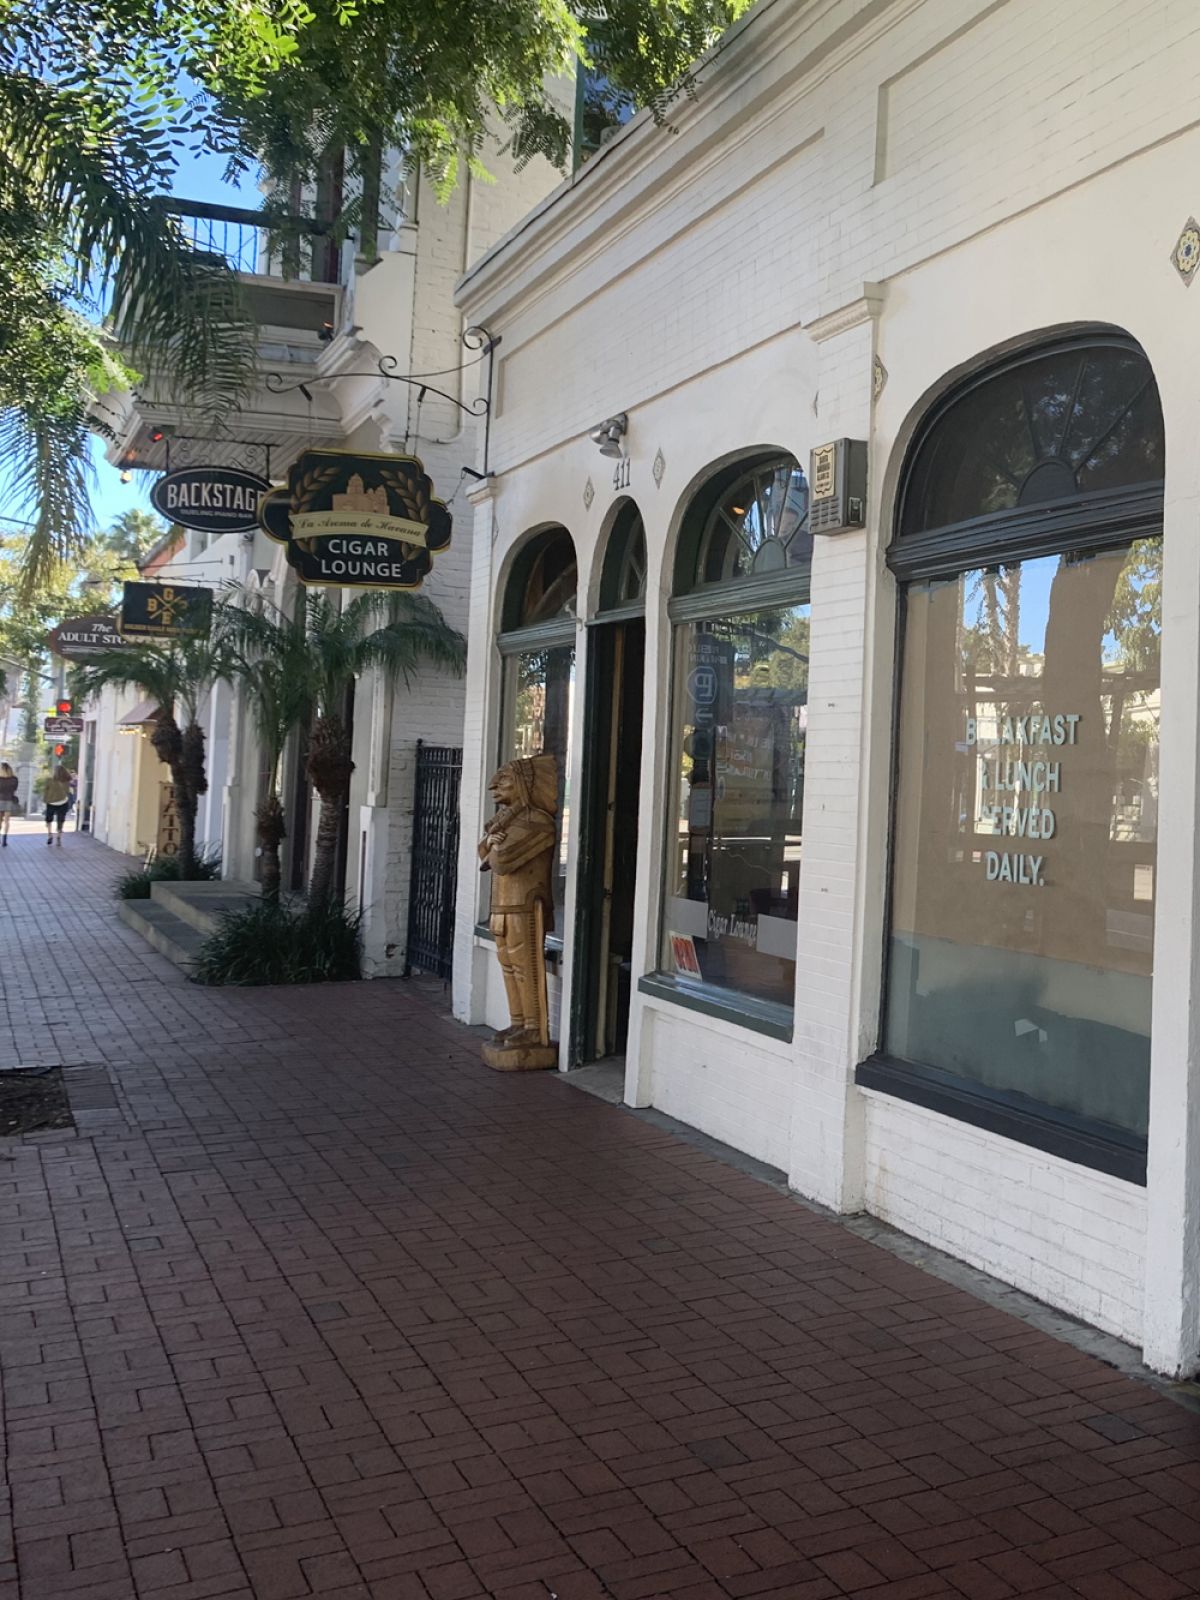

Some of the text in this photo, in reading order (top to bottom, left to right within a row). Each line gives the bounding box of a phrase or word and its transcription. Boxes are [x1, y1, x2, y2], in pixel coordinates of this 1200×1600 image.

[612, 458, 631, 490] 411
[328, 539, 388, 557] CIGAR
[321, 559, 402, 577] LOUNGE
[57, 632, 100, 644] ADULT
[91, 624, 113, 633] The
[966, 714, 1080, 745] BAKFAST
[995, 762, 1060, 792] LUNCH
[986, 850, 1045, 887] DAILY.
